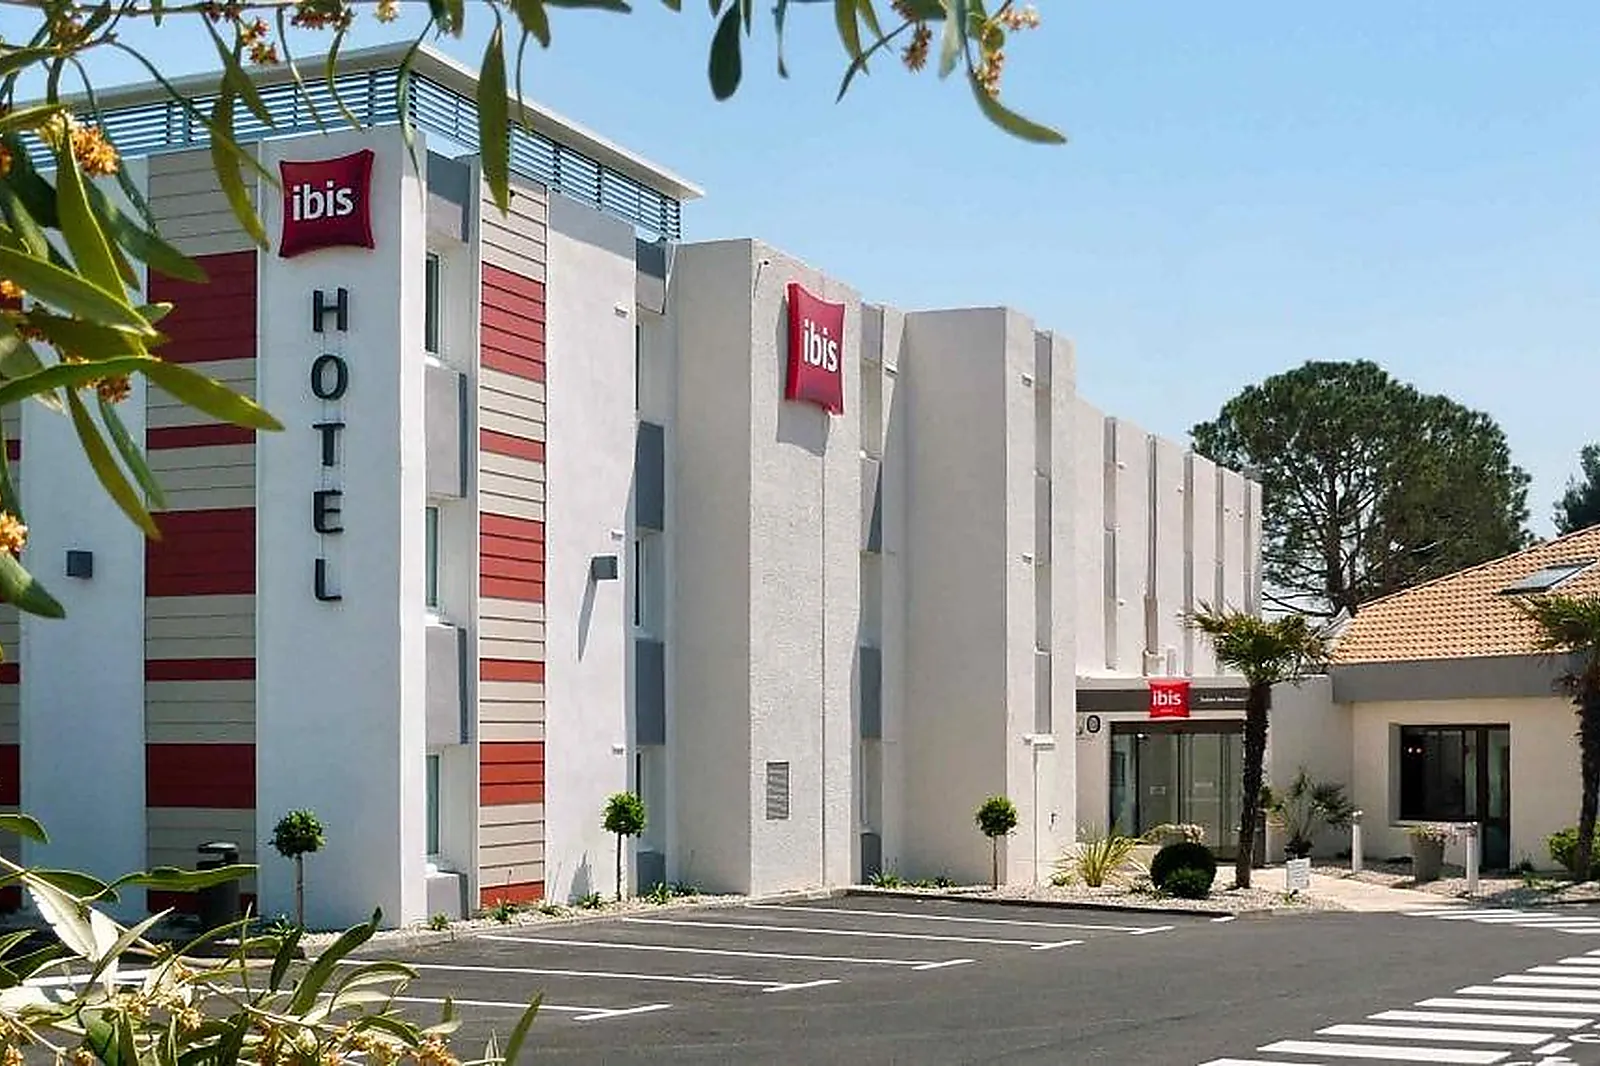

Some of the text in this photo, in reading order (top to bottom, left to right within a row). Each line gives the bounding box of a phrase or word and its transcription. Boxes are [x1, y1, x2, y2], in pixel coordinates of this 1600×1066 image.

[293, 180, 354, 221] ibis
[804, 318, 838, 373] ibis
[311, 287, 349, 601] HOTEL
[1152, 689, 1182, 706] ibis
